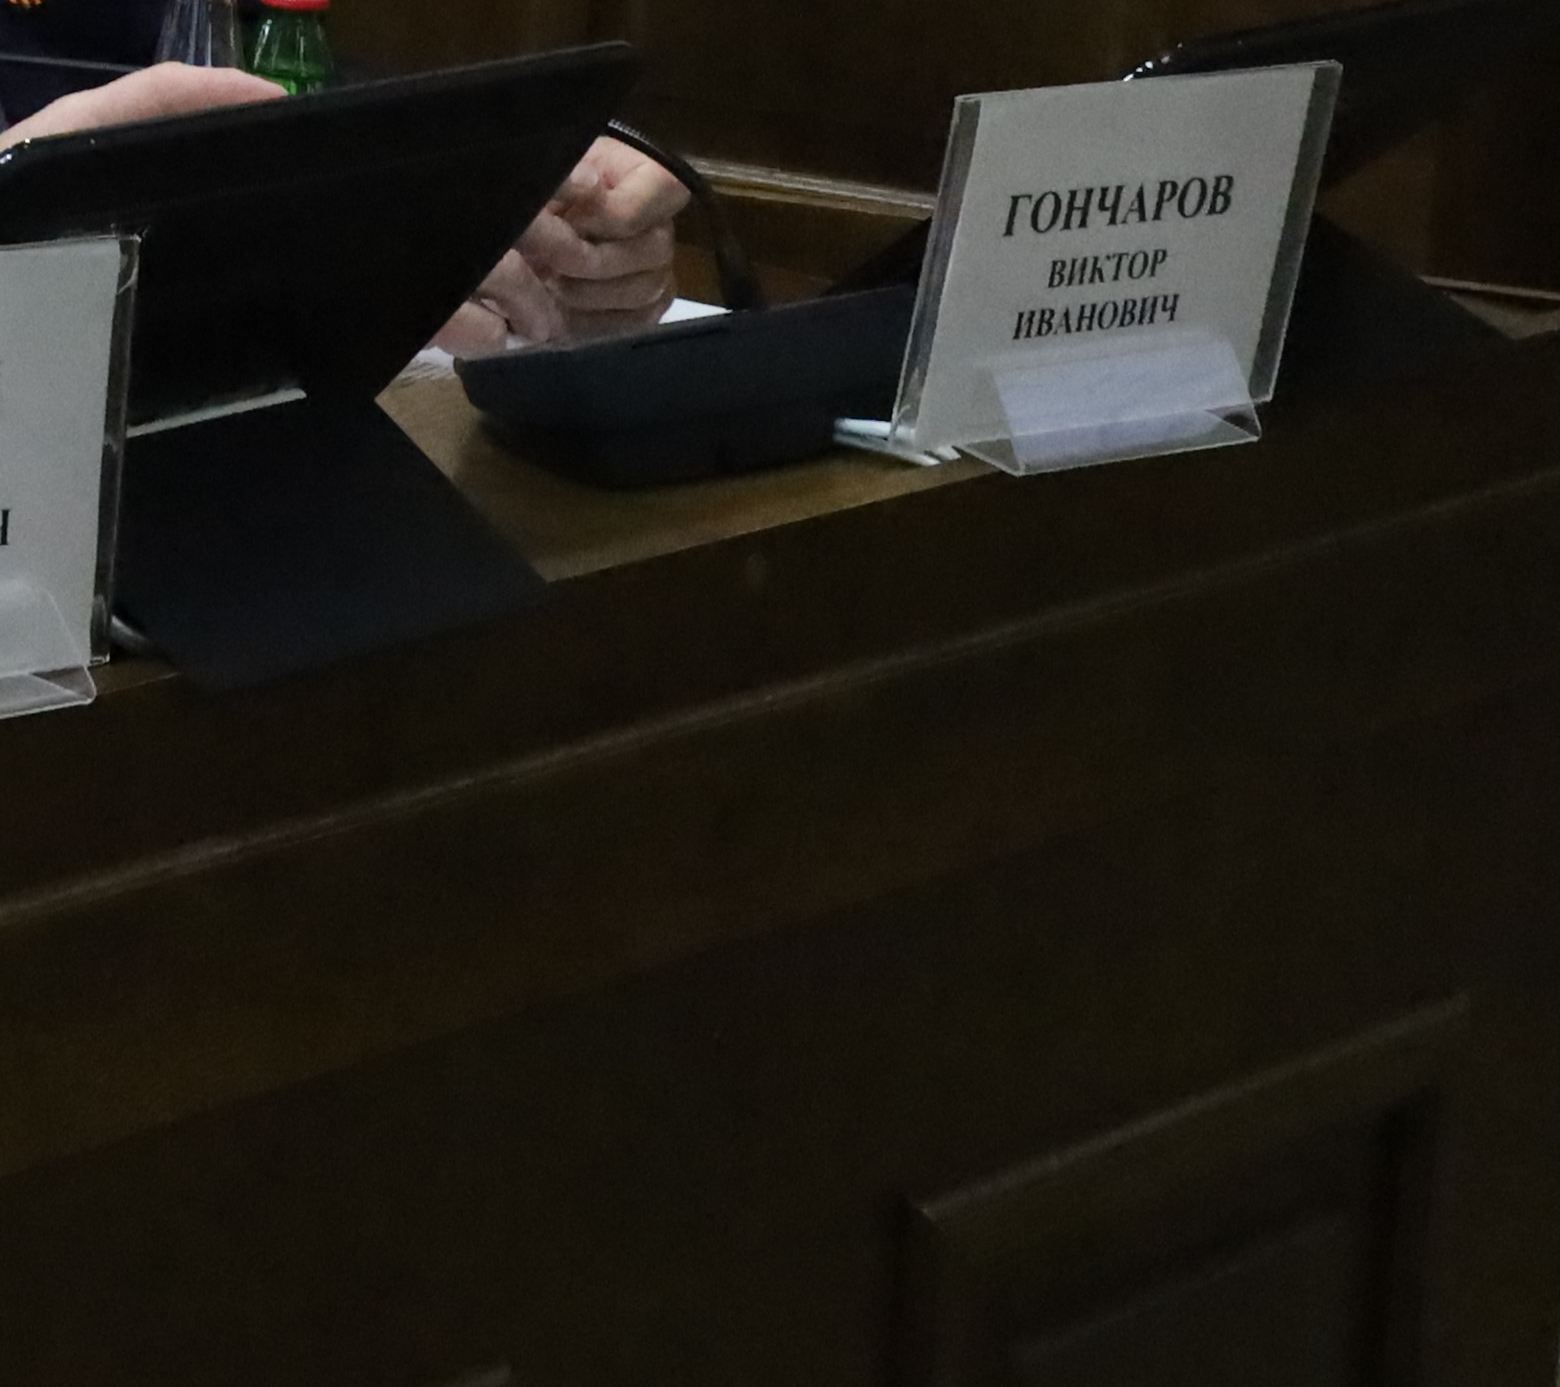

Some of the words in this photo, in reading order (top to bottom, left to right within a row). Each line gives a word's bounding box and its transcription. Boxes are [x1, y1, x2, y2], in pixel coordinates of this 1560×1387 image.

[1003, 175, 1234, 237] ГОНЧАРОВ
[1048, 249, 1167, 288] ВИКТОР
[1013, 294, 1179, 339] ИВАНОВИЧ
